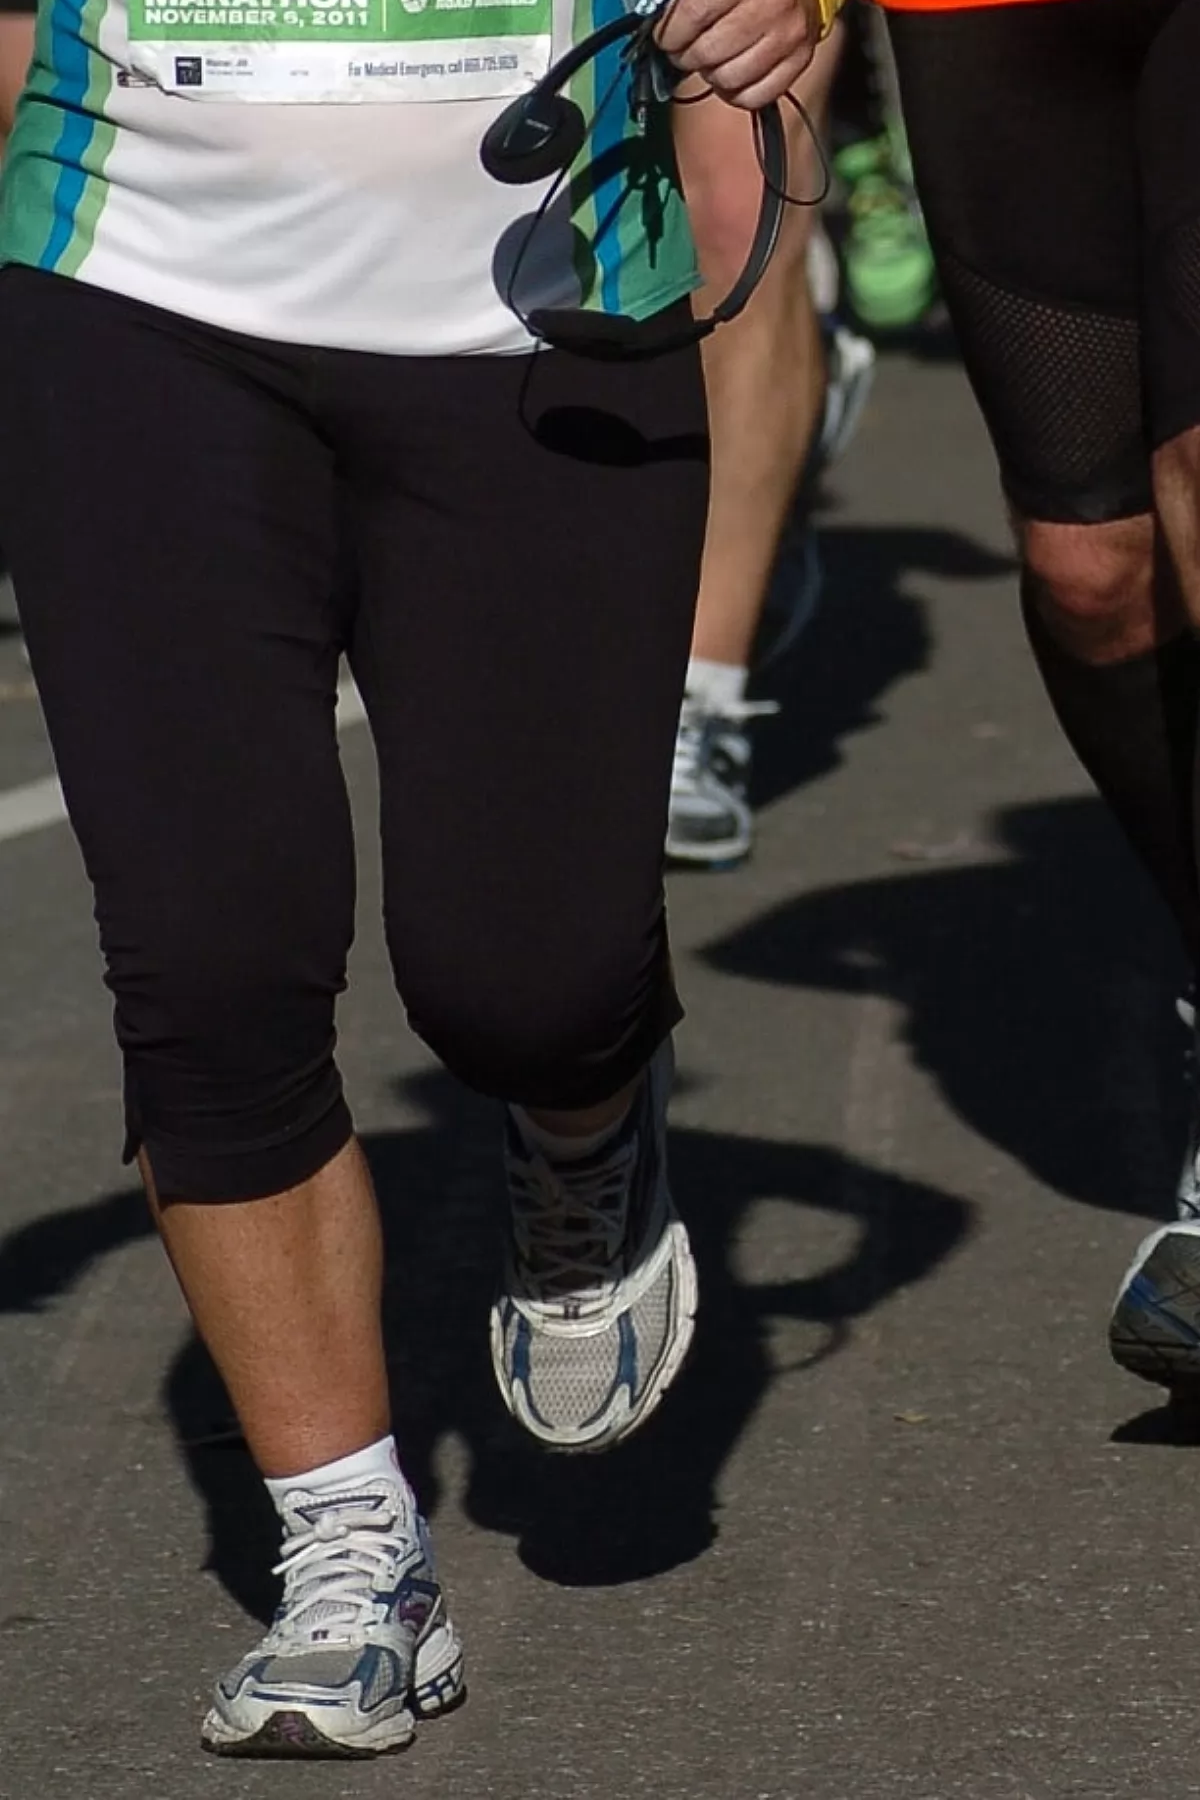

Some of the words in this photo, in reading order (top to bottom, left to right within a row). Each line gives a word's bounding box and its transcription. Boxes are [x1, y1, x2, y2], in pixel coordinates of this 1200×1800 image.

[144, 9, 277, 26] NOVEMBER
[283, 10, 304, 29] 6,
[311, 10, 369, 27] 2011
